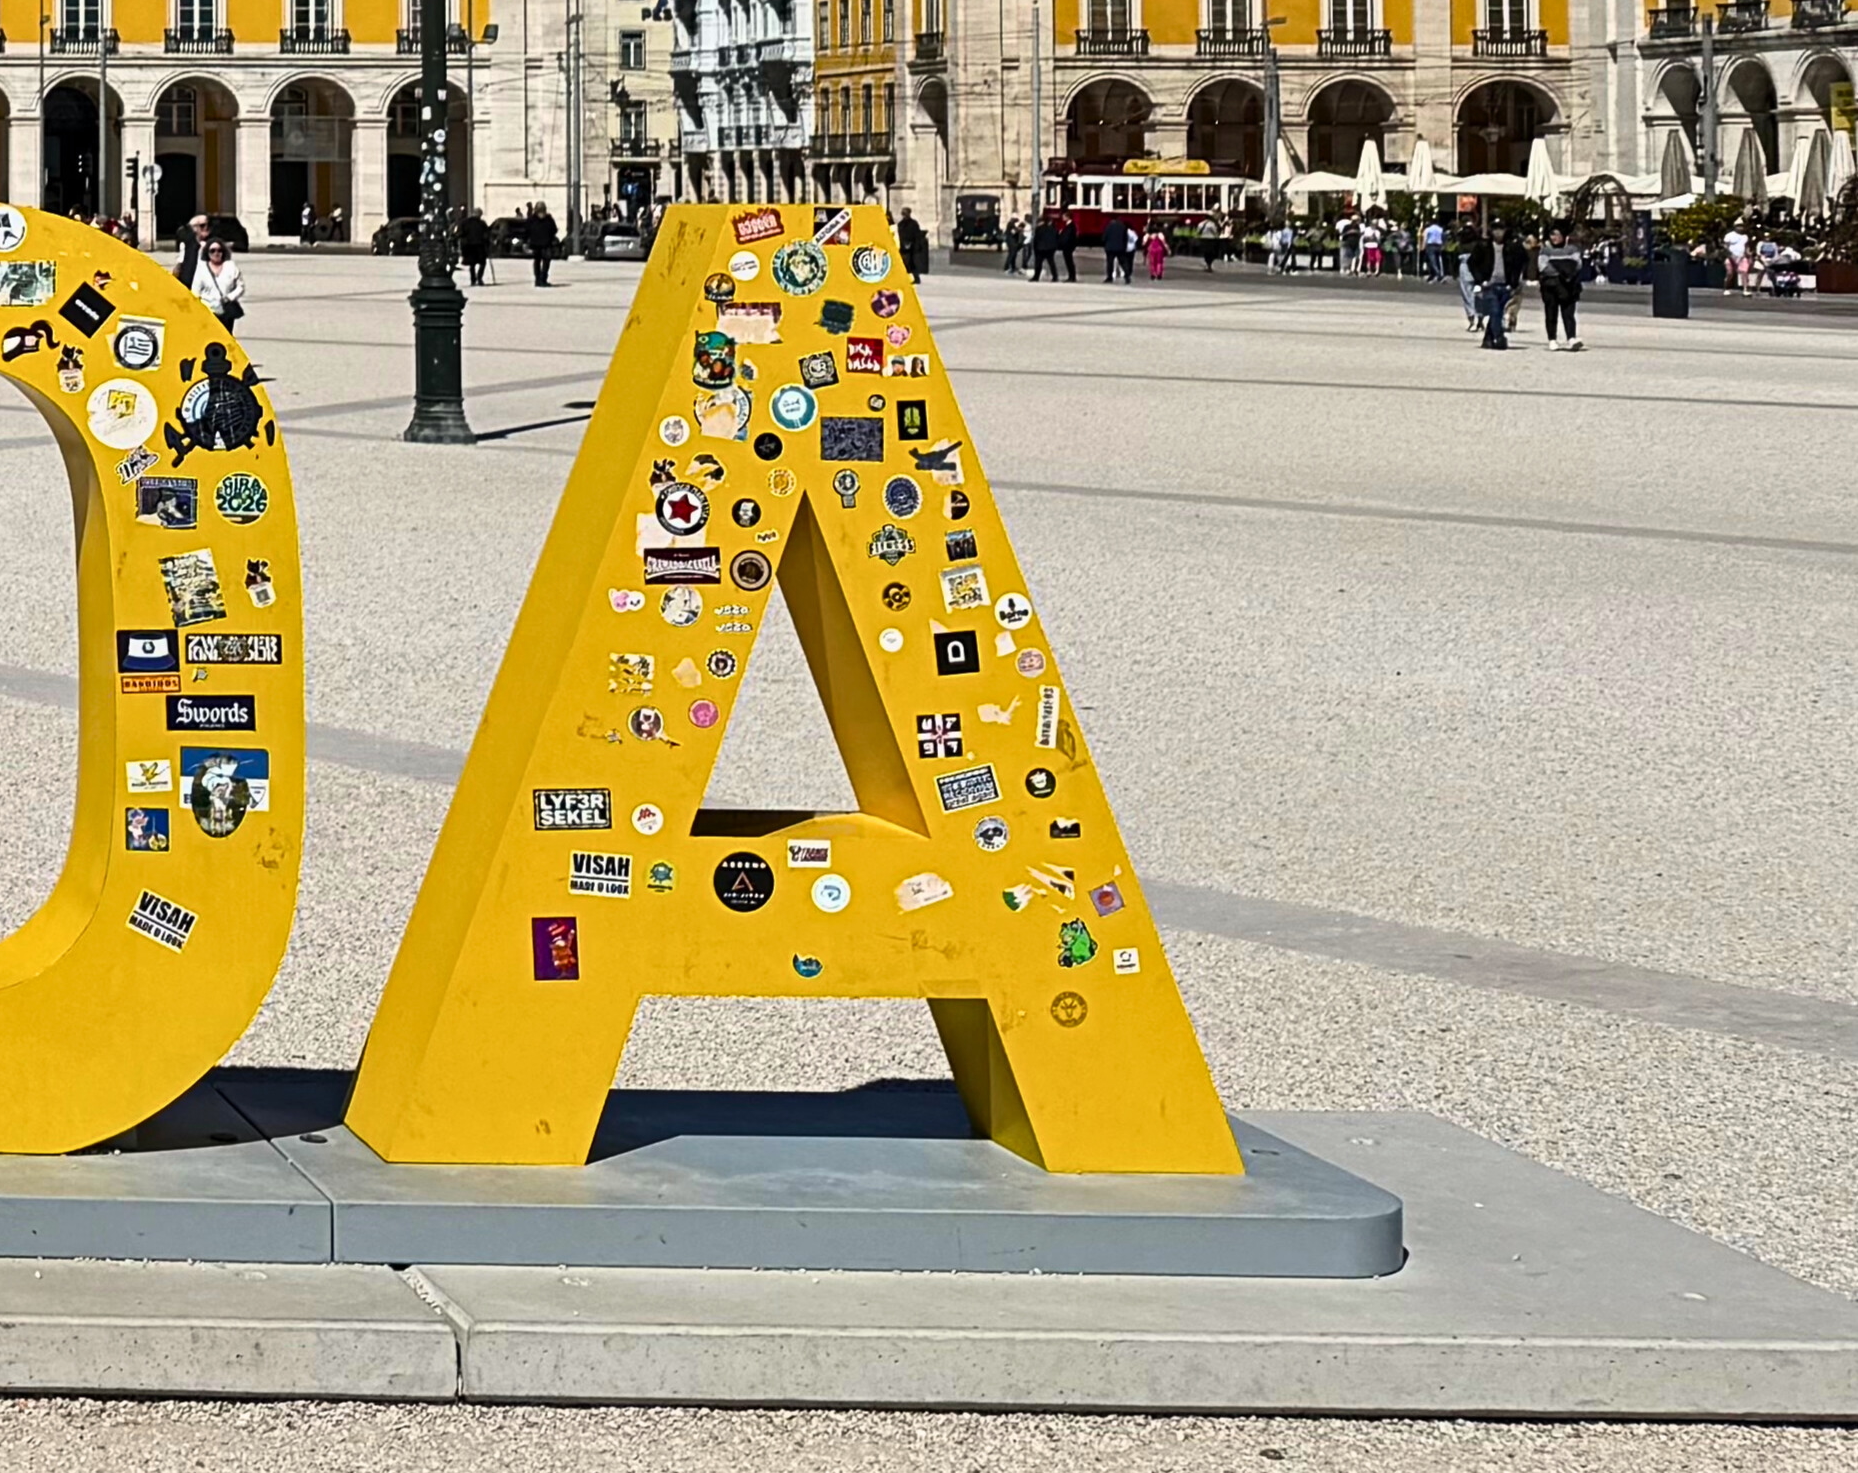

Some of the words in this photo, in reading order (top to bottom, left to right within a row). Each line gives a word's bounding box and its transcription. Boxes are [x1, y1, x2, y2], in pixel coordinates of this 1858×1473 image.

[217, 497, 268, 513] 2026
[175, 698, 249, 724] Swords
[540, 793, 604, 810] LYF3R
[541, 809, 607, 826] SEKEL
[573, 853, 631, 877] VISAH
[139, 890, 196, 933] VISAH
